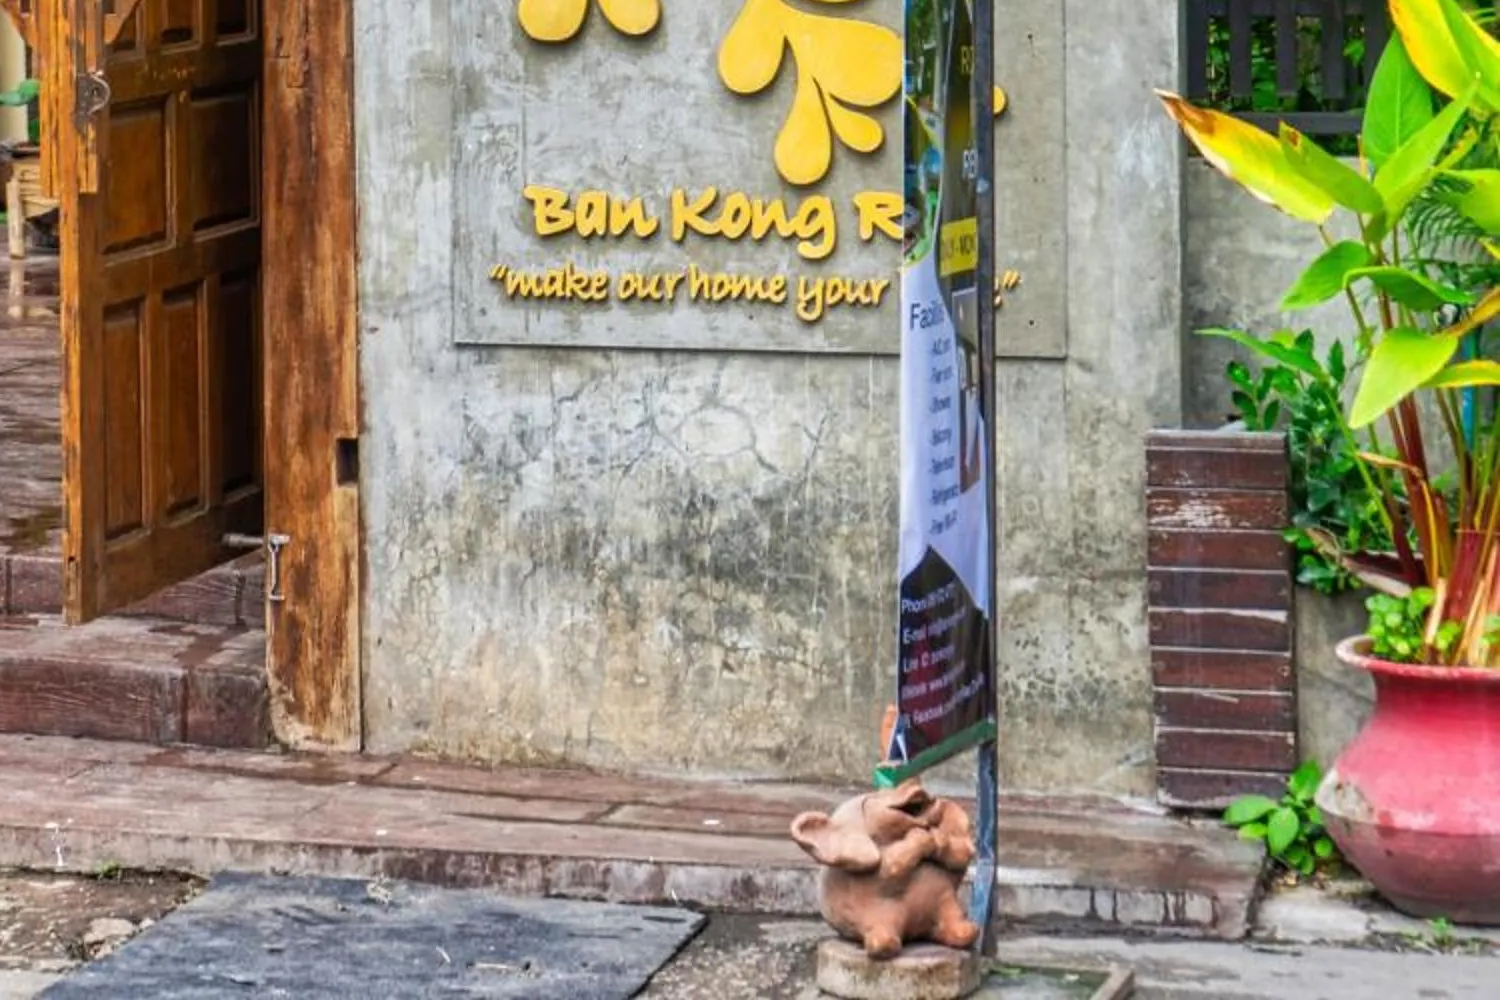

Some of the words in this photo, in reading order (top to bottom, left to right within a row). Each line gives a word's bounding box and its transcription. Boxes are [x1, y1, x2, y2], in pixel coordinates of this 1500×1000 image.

[524, 185, 659, 237] Ban
[671, 185, 836, 259] Kong
[617, 271, 687, 300] our
[688, 263, 788, 303] home
[796, 273, 890, 322] your
